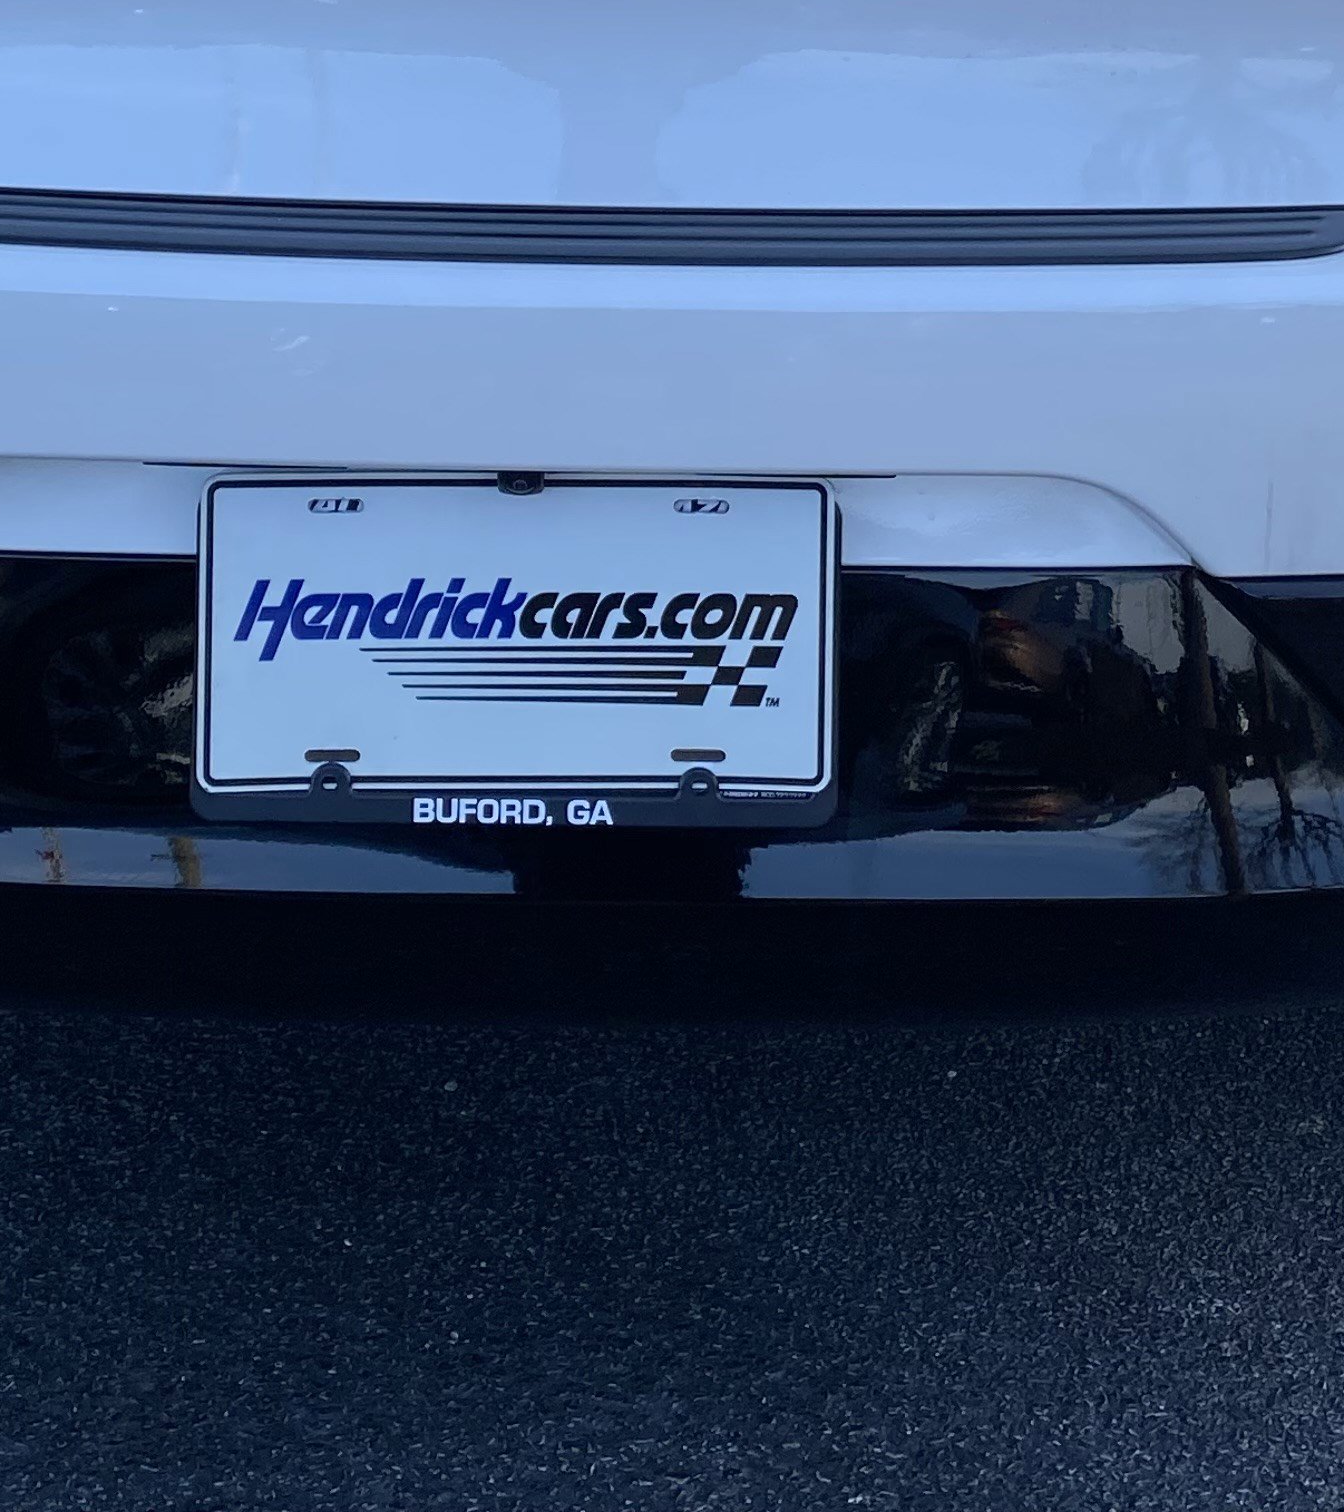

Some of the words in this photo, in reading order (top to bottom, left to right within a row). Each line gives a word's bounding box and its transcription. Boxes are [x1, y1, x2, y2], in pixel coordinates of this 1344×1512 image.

[233, 577, 799, 662] Hendrickcars.com
[412, 797, 553, 826] BUFORD,
[566, 799, 614, 826] GA
